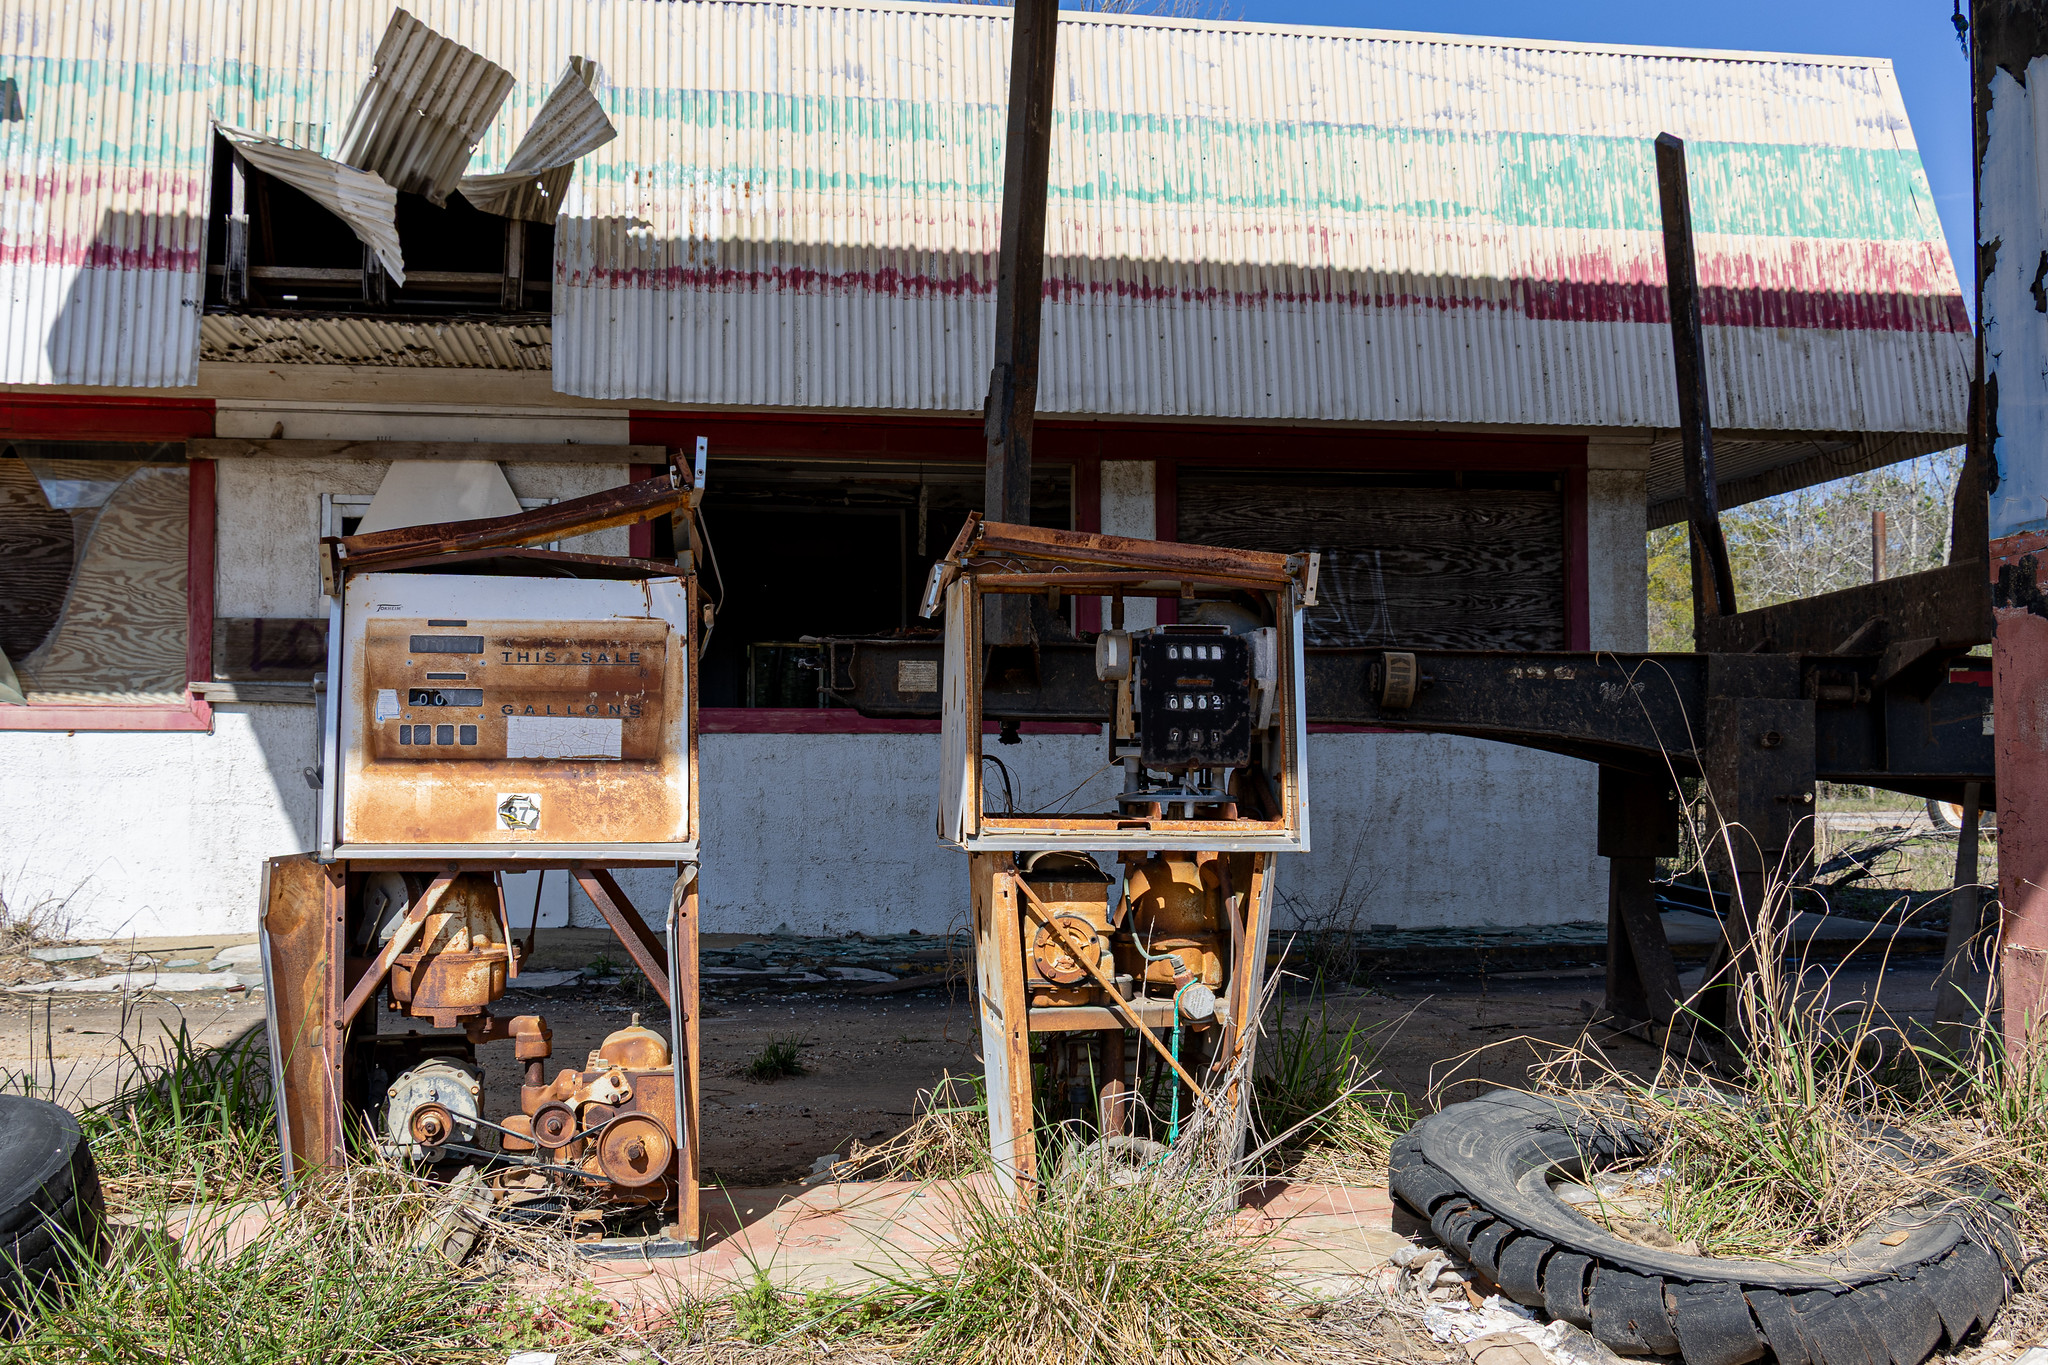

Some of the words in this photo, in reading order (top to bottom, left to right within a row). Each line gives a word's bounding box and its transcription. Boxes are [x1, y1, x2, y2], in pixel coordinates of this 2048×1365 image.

[501, 651, 557, 663] THIS
[581, 651, 641, 664] SALE
[501, 704, 641, 716] GALLONS
[507, 805, 529, 822] 87
